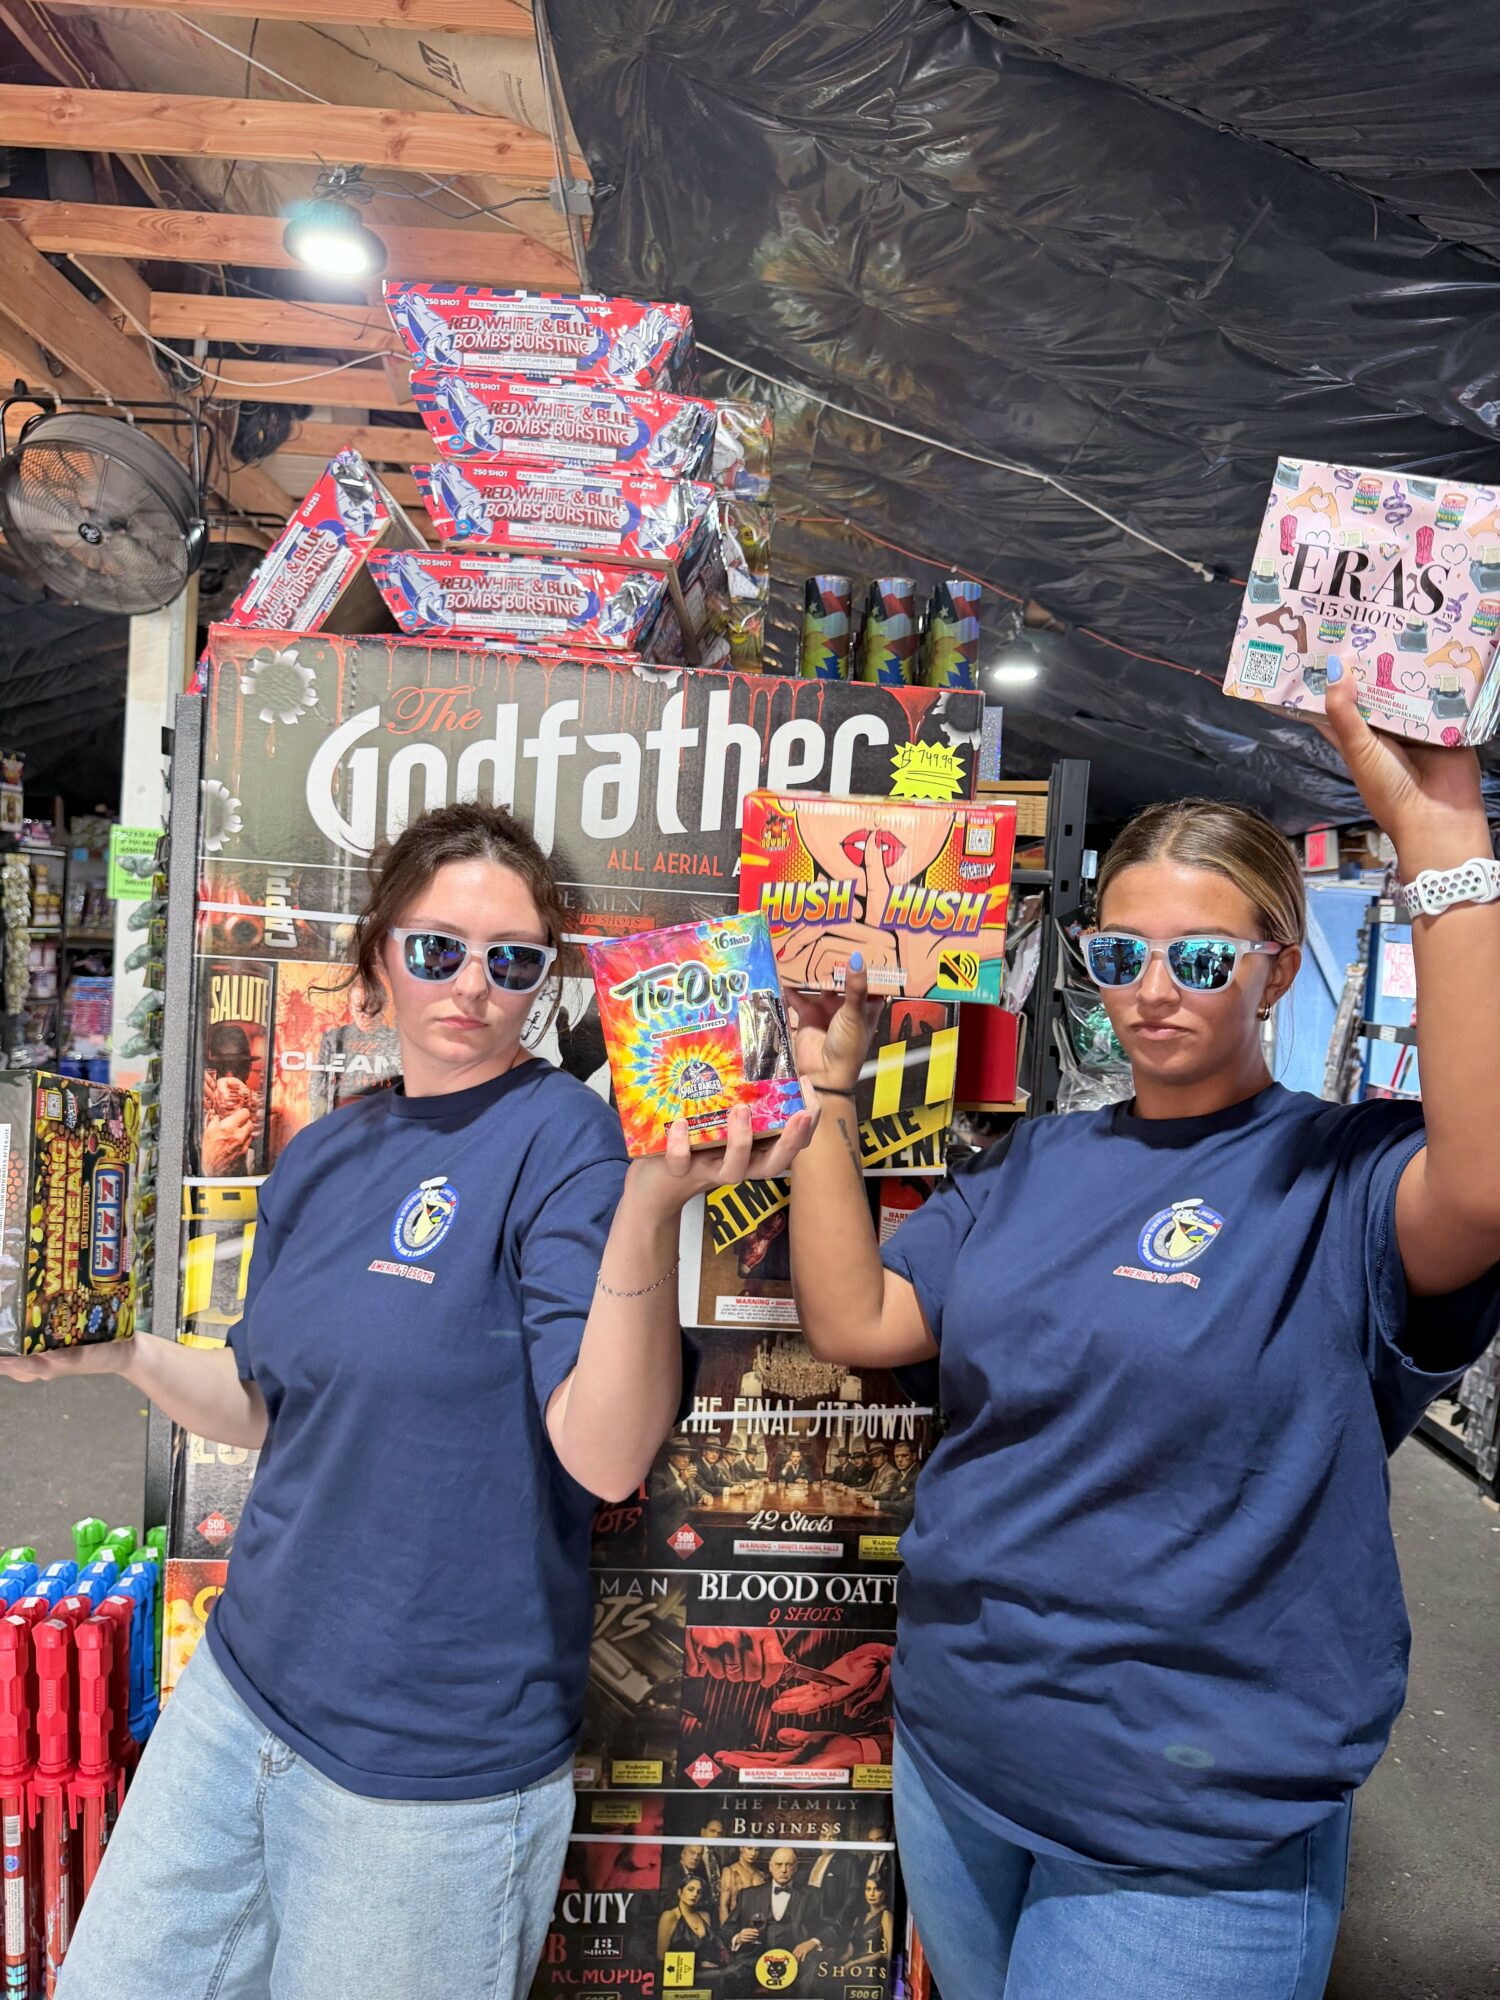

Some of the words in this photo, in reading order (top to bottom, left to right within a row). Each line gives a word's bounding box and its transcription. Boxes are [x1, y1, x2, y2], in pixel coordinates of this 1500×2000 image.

[449, 316, 481, 331] RED,
[486, 316, 538, 334] WHITE,
[541, 318, 554, 333] &
[557, 319, 594, 338] BLUE
[453, 333, 510, 350] BOMBS
[514, 334, 593, 356] BURSTING
[480, 383, 501, 391] SHOT
[488, 401, 522, 417] RED,
[526, 402, 578, 420] WHITE,
[582, 405, 594, 421] &
[597, 408, 635, 427] BLUE
[493, 418, 550, 437] BOMBS
[554, 420, 632, 446] BURSTING
[473, 468, 487, 476] 250
[488, 469, 508, 477] SHOT
[481, 486, 513, 501] RED,
[519, 487, 570, 504] WHITE,
[573, 490, 585, 505] &
[588, 491, 626, 509] BLUE
[486, 503, 542, 519] BOMBS
[545, 504, 622, 529] BURSTING
[286, 562, 300, 574] &
[293, 527, 326, 561] BLUE
[287, 540, 338, 607] BURSTING
[1284, 542, 1450, 616] ERAS
[439, 576, 473, 591] RED,
[477, 577, 530, 595] WHITE,
[532, 579, 545, 593] &
[547, 580, 585, 599] BLUE
[445, 593, 501, 610] BOMBS
[505, 594, 582, 617] BURSTING
[1316, 601, 1338, 617] 15
[1341, 603, 1405, 631] SHOTS
[1367, 685, 1395, 700] WARNING
[387, 684, 484, 735] The
[1392, 701, 1408, 711] BALLS
[306, 689, 890, 859] Godfather
[607, 848, 645, 872] ALL
[653, 852, 724, 878] AERIAL
[761, 879, 854, 924] HUSH
[884, 883, 988, 934] HUSH
[712, 932, 728, 949] 16
[729, 934, 751, 946] Shots
[210, 974, 269, 1027] SALUTE
[612, 963, 748, 1020] Tie-Dye
[701, 1019, 725, 1029] EFFECTS
[681, 1082, 698, 1099] SPACE
[698, 1079, 721, 1091] RANGER
[860, 1109, 922, 1158] ENE
[46, 1139, 66, 1296] WINNING
[64, 1139, 83, 1291] STREAK
[370, 1260, 407, 1276] AMERICA'S
[407, 1266, 433, 1283] 250TH
[1116, 1266, 1167, 1284] AMERICA'S
[736, 1297, 770, 1306] WARNING
[733, 1397, 801, 1437] FINAL
[806, 1399, 916, 1441] SIT-DOWN
[207, 1518, 225, 1530] 500
[746, 1509, 778, 1531] 42
[781, 1509, 834, 1533] Shots
[205, 1529, 227, 1537] GRAMS
[677, 1531, 695, 1542] 500
[739, 1542, 772, 1550] WARNING
[697, 1573, 820, 1601] BLOOD
[768, 1606, 780, 1626] 9
[784, 1606, 844, 1623] SHOTS
[695, 1760, 713, 1771] 500
[744, 1770, 778, 1778] WARNING
[777, 1795, 859, 1811] FAMILY
[733, 1818, 842, 1834] BUSINESS
[562, 1892, 634, 1925] CITY
[594, 1938, 612, 1948] 13
[764, 1955, 790, 1964] Black
[817, 1961, 887, 1979] SHOTS
[766, 1978, 783, 1987] Cat
[850, 1990, 868, 1999] 500
